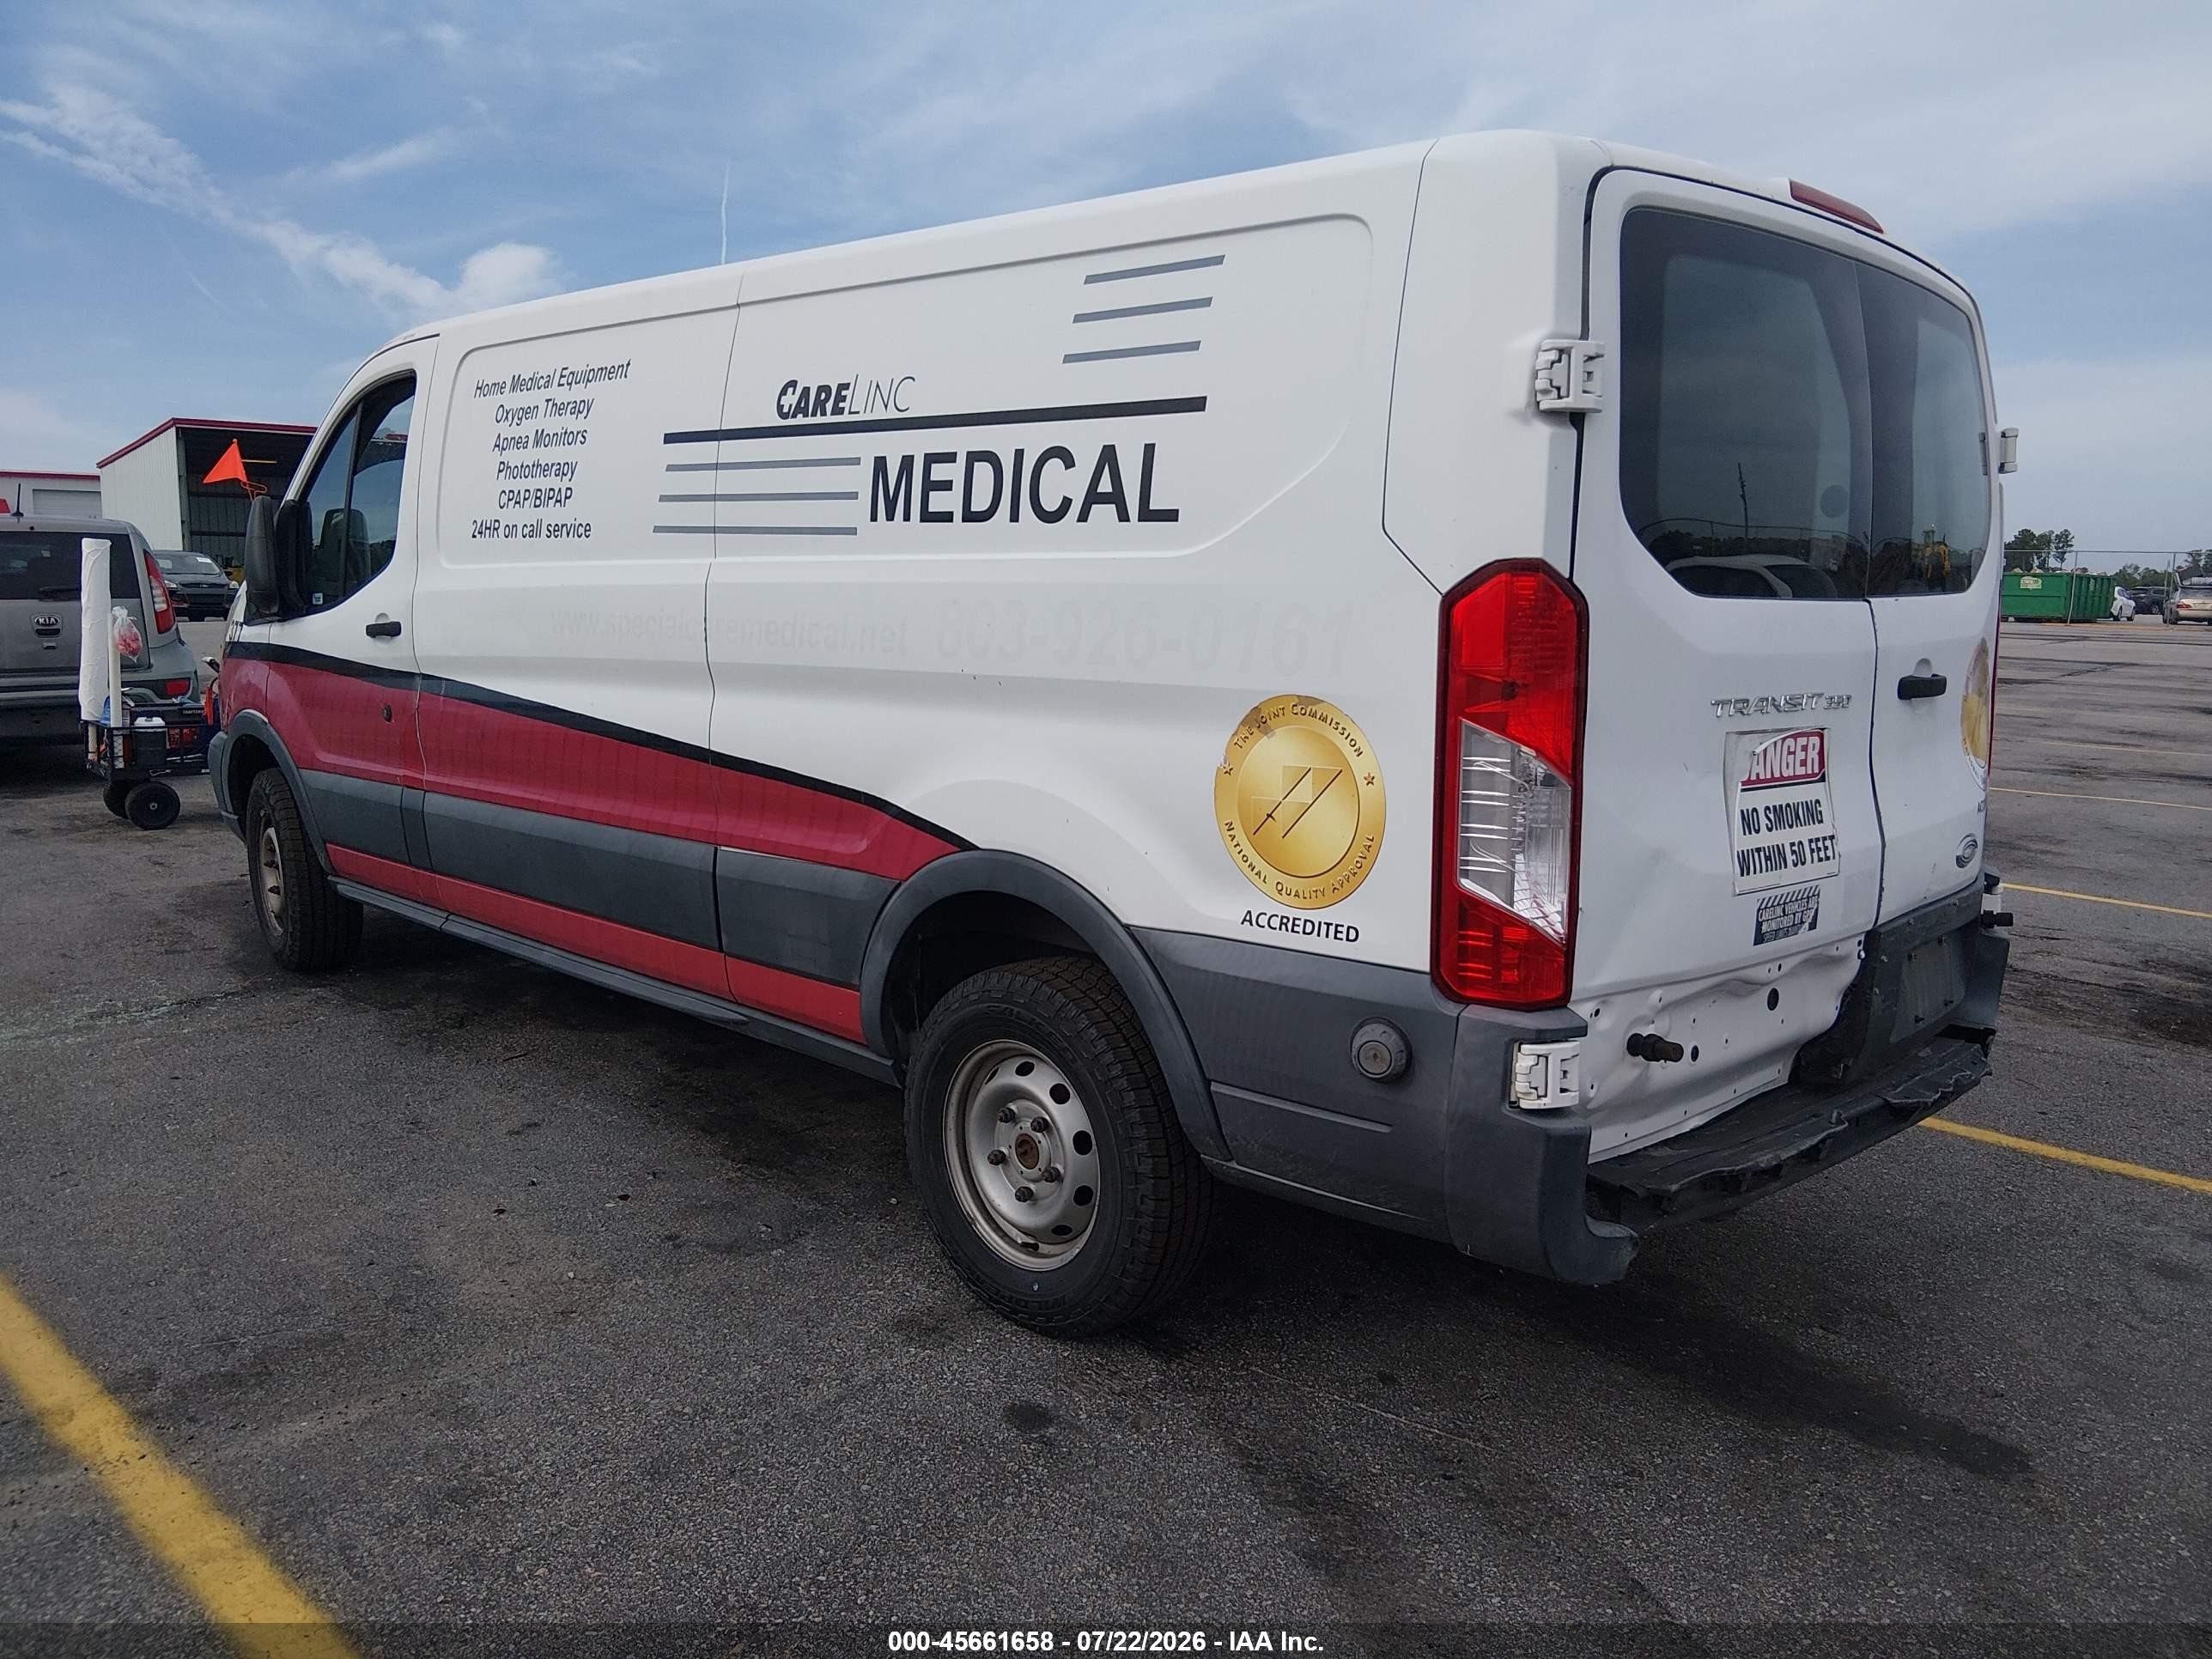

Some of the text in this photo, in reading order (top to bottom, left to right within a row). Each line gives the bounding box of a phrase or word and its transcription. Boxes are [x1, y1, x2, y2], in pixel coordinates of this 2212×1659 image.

[474, 358, 631, 398] Home Medical Equipment
[495, 398, 595, 427] Oxygen Therapy
[492, 427, 587, 456] Apnea Monitors
[496, 459, 578, 482] Phototherapy
[869, 442, 1180, 525] MEDICAL
[498, 487, 573, 509] CPAP/BIPAP
[471, 518, 592, 539] 24HR on call service
[1711, 692, 1825, 718] TRANSIT
[1233, 704, 1364, 757] THE JOINT COMMISSION
[1748, 736, 1820, 781] ANGER
[1740, 799, 1824, 836] NO SMOKING
[1224, 819, 1375, 900] NATIONAL QUALITY APPROVAL
[1736, 835, 1836, 877] WITHIN 50 FEET
[1240, 909, 1360, 943] ACCREDITED
